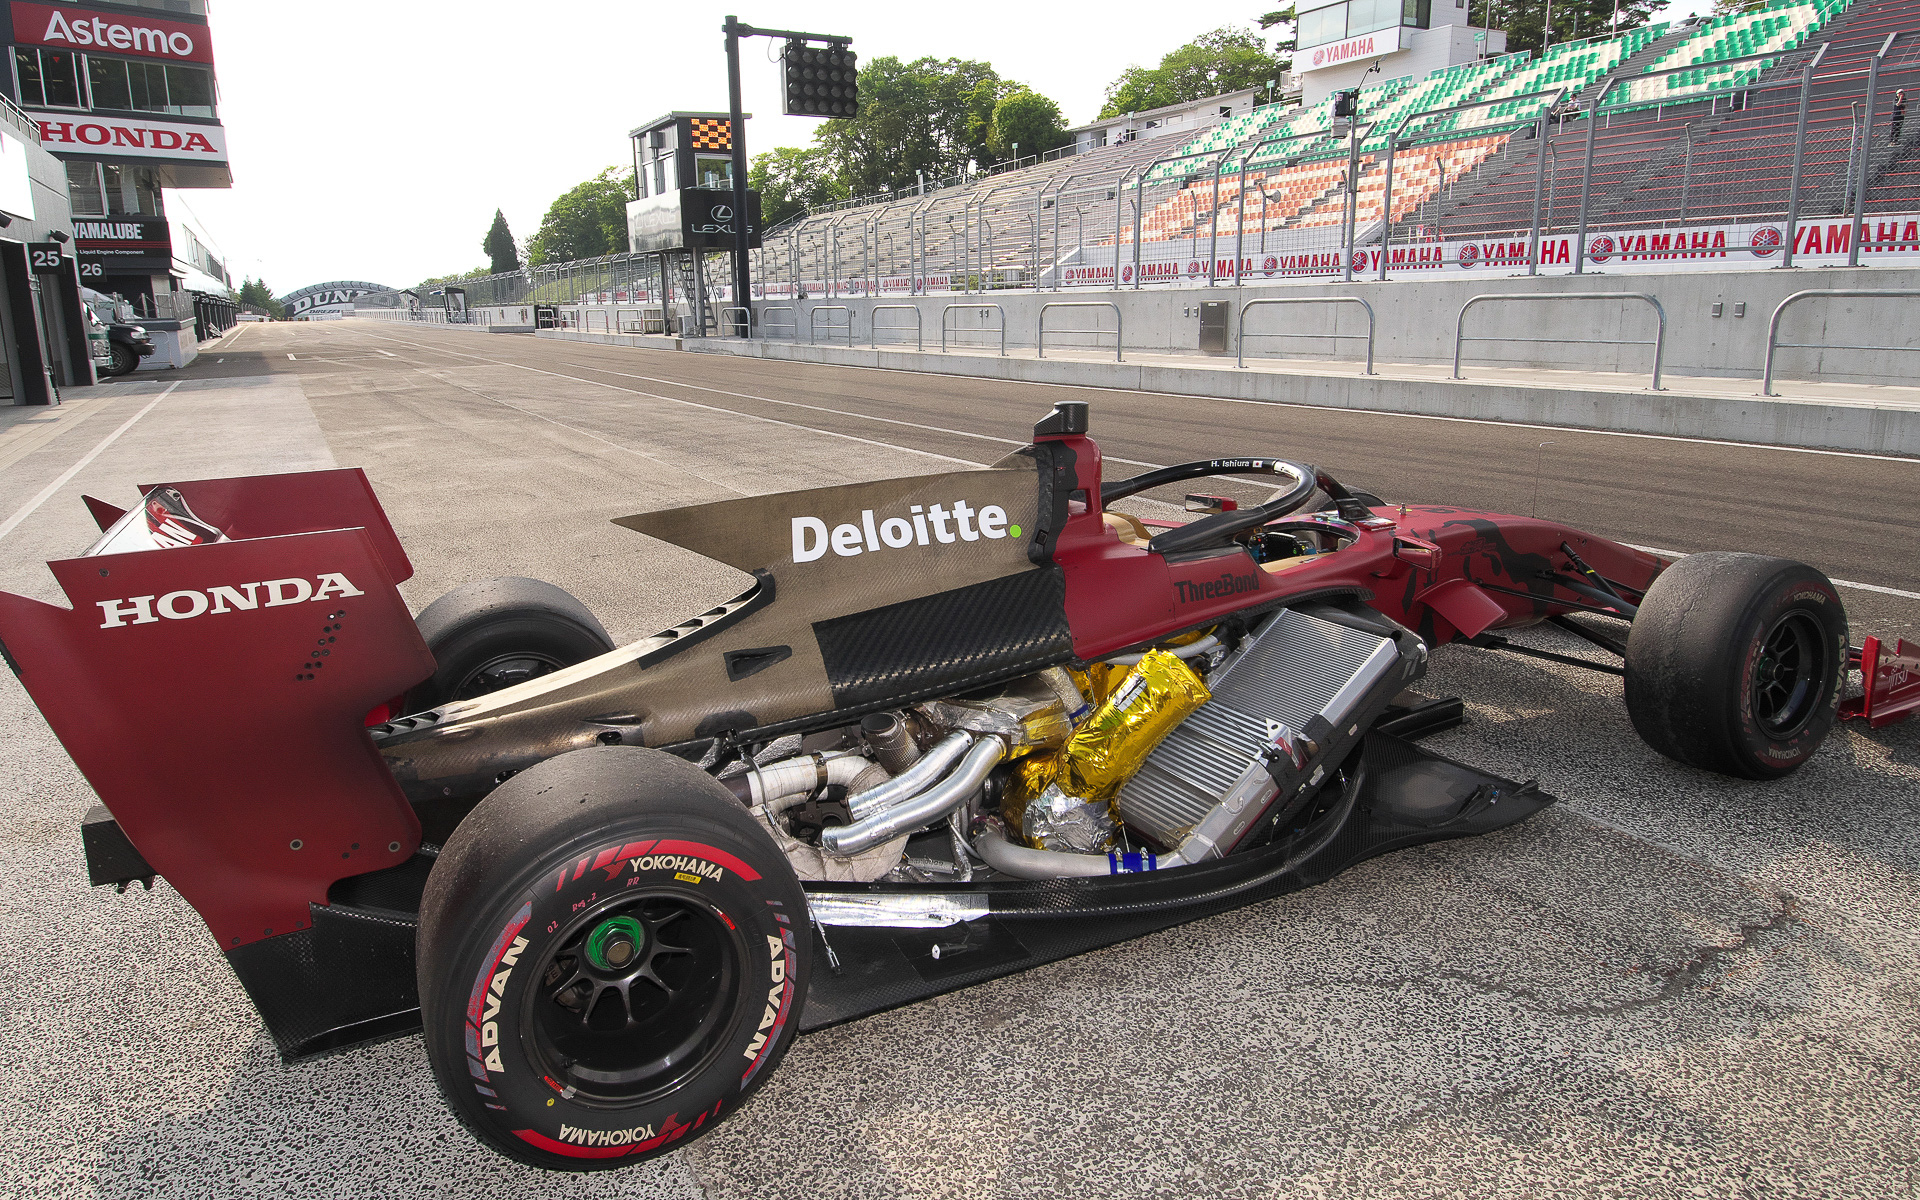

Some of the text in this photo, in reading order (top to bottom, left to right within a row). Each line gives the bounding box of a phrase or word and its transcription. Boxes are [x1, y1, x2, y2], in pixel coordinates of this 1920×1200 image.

[43, 10, 193, 56] Astemo
[1327, 37, 1374, 63] YAMAHA
[40, 121, 218, 153] HONDA
[72, 222, 143, 239] YAMALUBE
[33, 250, 60, 267] 25
[1619, 230, 1727, 261] YAMAHA
[81, 263, 103, 276] 26
[1202, 258, 1253, 279] YMAA
[1280, 252, 1341, 277] YAMAHA
[293, 289, 367, 315] DUN
[1211, 459, 1250, 468] H. Ishiura
[791, 499, 1021, 563] Deloitte.
[96, 572, 364, 629] HONDA
[1174, 569, 1260, 604] ThreeBond
[1829, 633, 1846, 709] ADVAN
[629, 855, 724, 883] YOKOHAMA
[481, 936, 530, 1073] ADVAN
[743, 935, 785, 1061] ADVAN
[558, 1123, 656, 1146] YOKOHAMA
